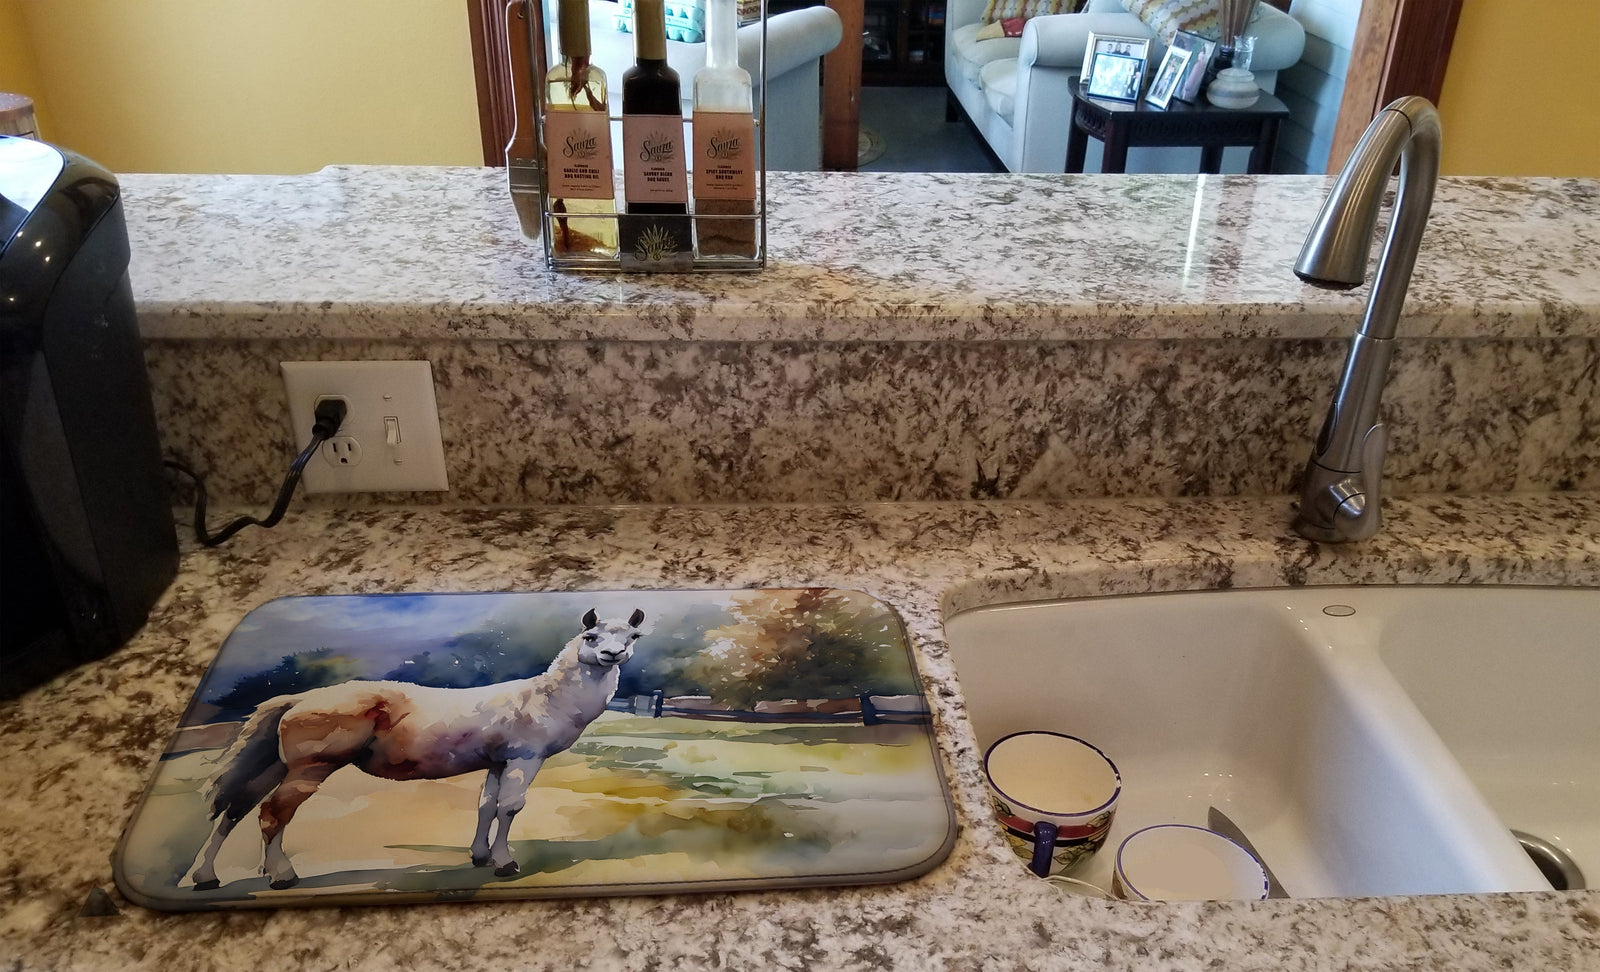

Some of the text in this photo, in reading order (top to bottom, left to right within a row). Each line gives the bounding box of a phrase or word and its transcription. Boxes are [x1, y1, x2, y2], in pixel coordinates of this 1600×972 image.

[562, 136, 597, 158] Sauza
[640, 140, 674, 162] Sauza
[706, 136, 740, 158] Sauza
